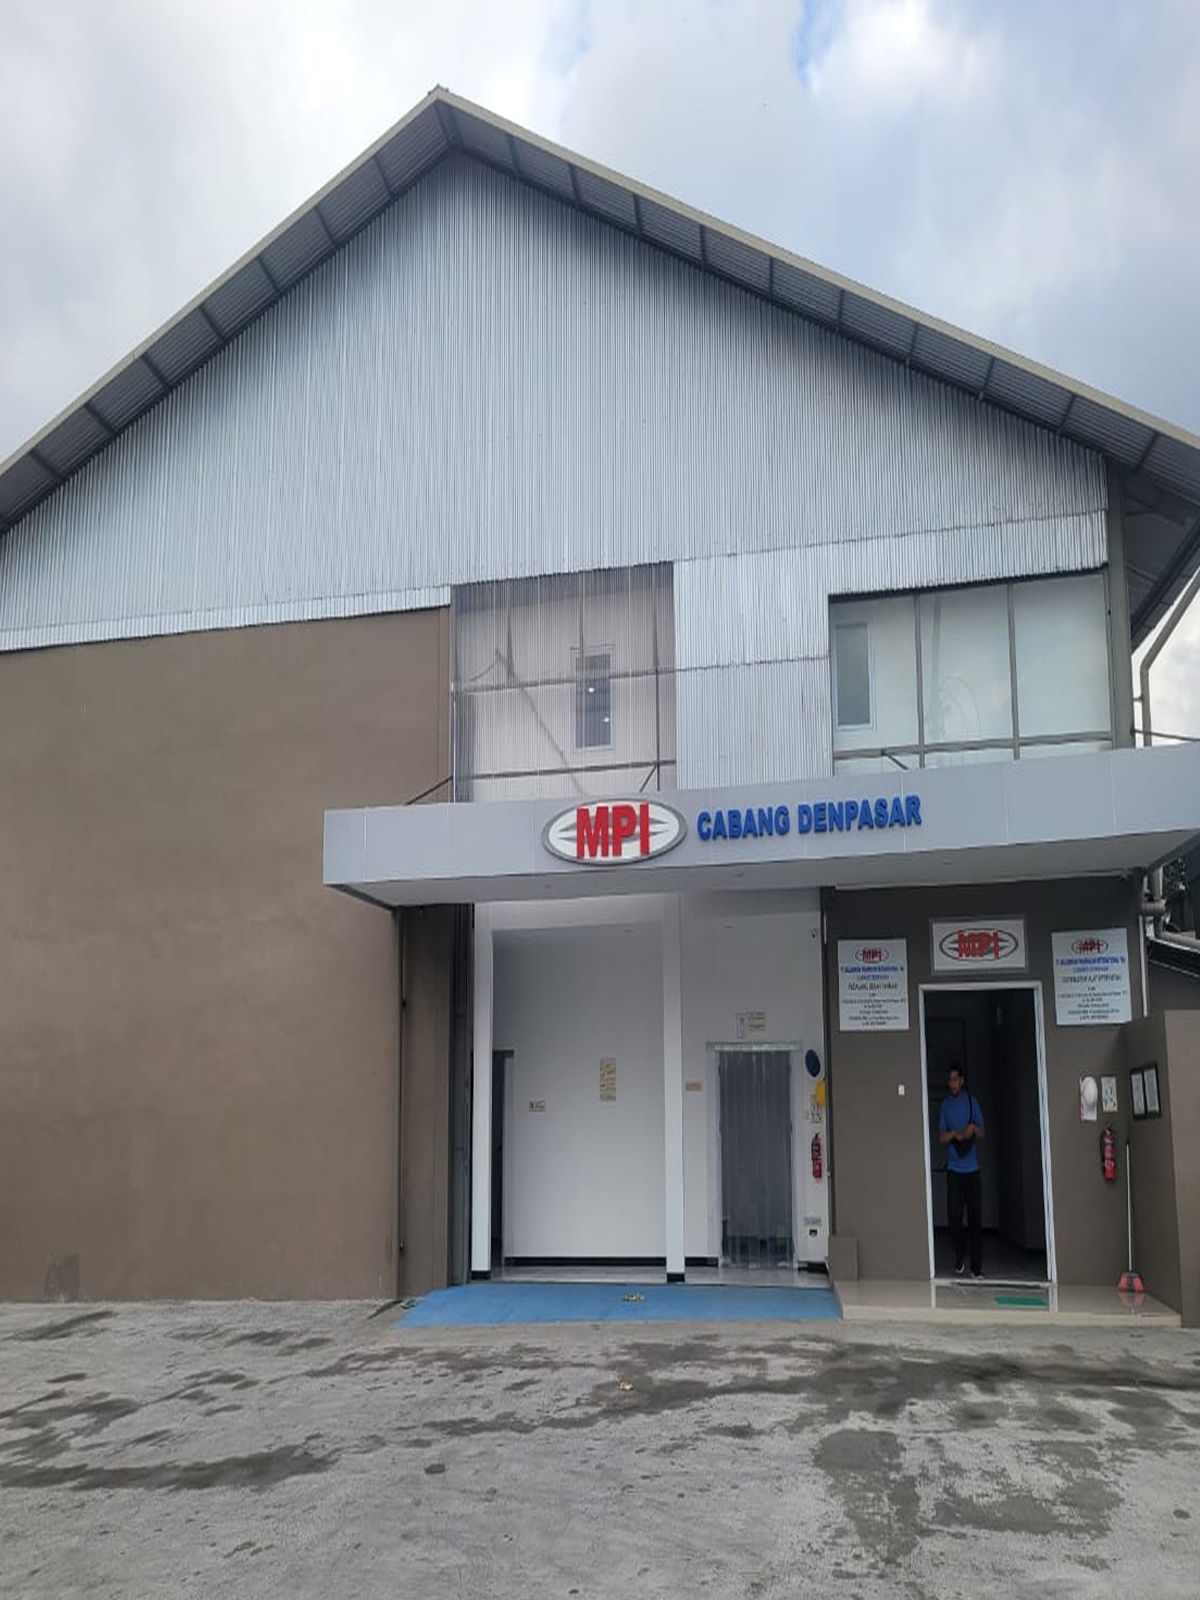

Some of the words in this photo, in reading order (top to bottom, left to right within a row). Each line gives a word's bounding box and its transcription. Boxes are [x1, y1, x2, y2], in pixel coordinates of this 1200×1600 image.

[576, 803, 650, 859] MPI
[697, 807, 791, 841] CABANG
[798, 795, 923, 834] DENPASAR
[862, 949, 883, 962] MPI
[958, 930, 1000, 959] MPI
